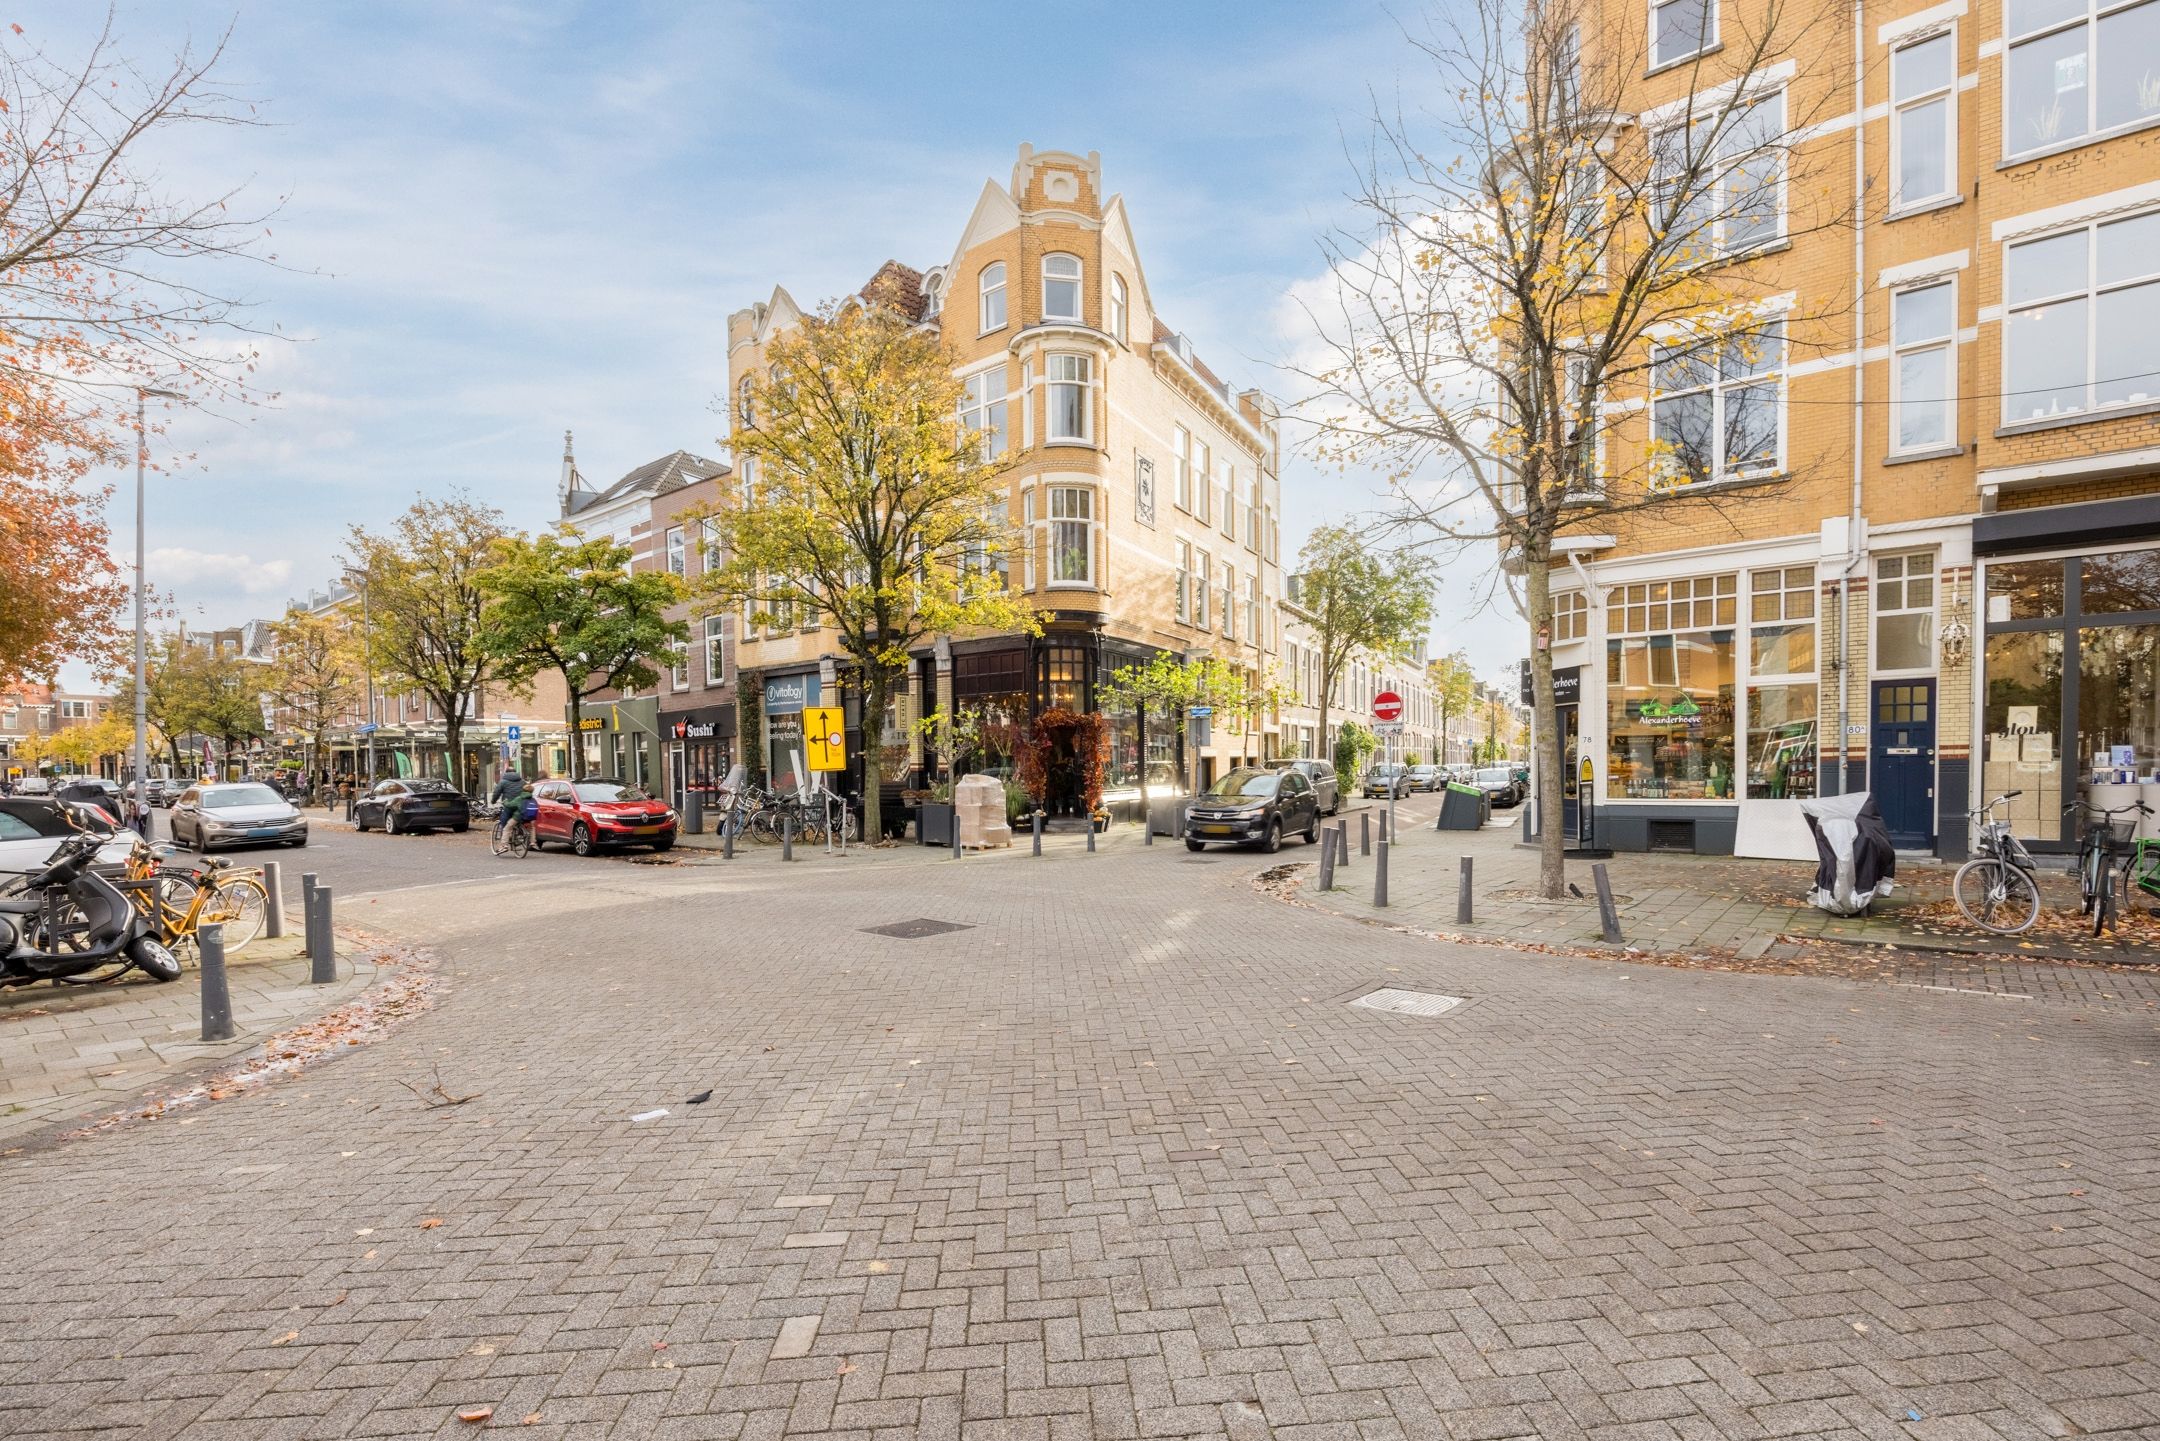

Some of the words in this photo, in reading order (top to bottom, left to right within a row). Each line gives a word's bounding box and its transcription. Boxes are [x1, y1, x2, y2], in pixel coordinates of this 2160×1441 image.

[1639, 715, 1701, 725] Alexanderhoeve
[671, 725, 677, 739] I
[687, 723, 714, 738] Sushi
[1583, 736, 1592, 744] 78
